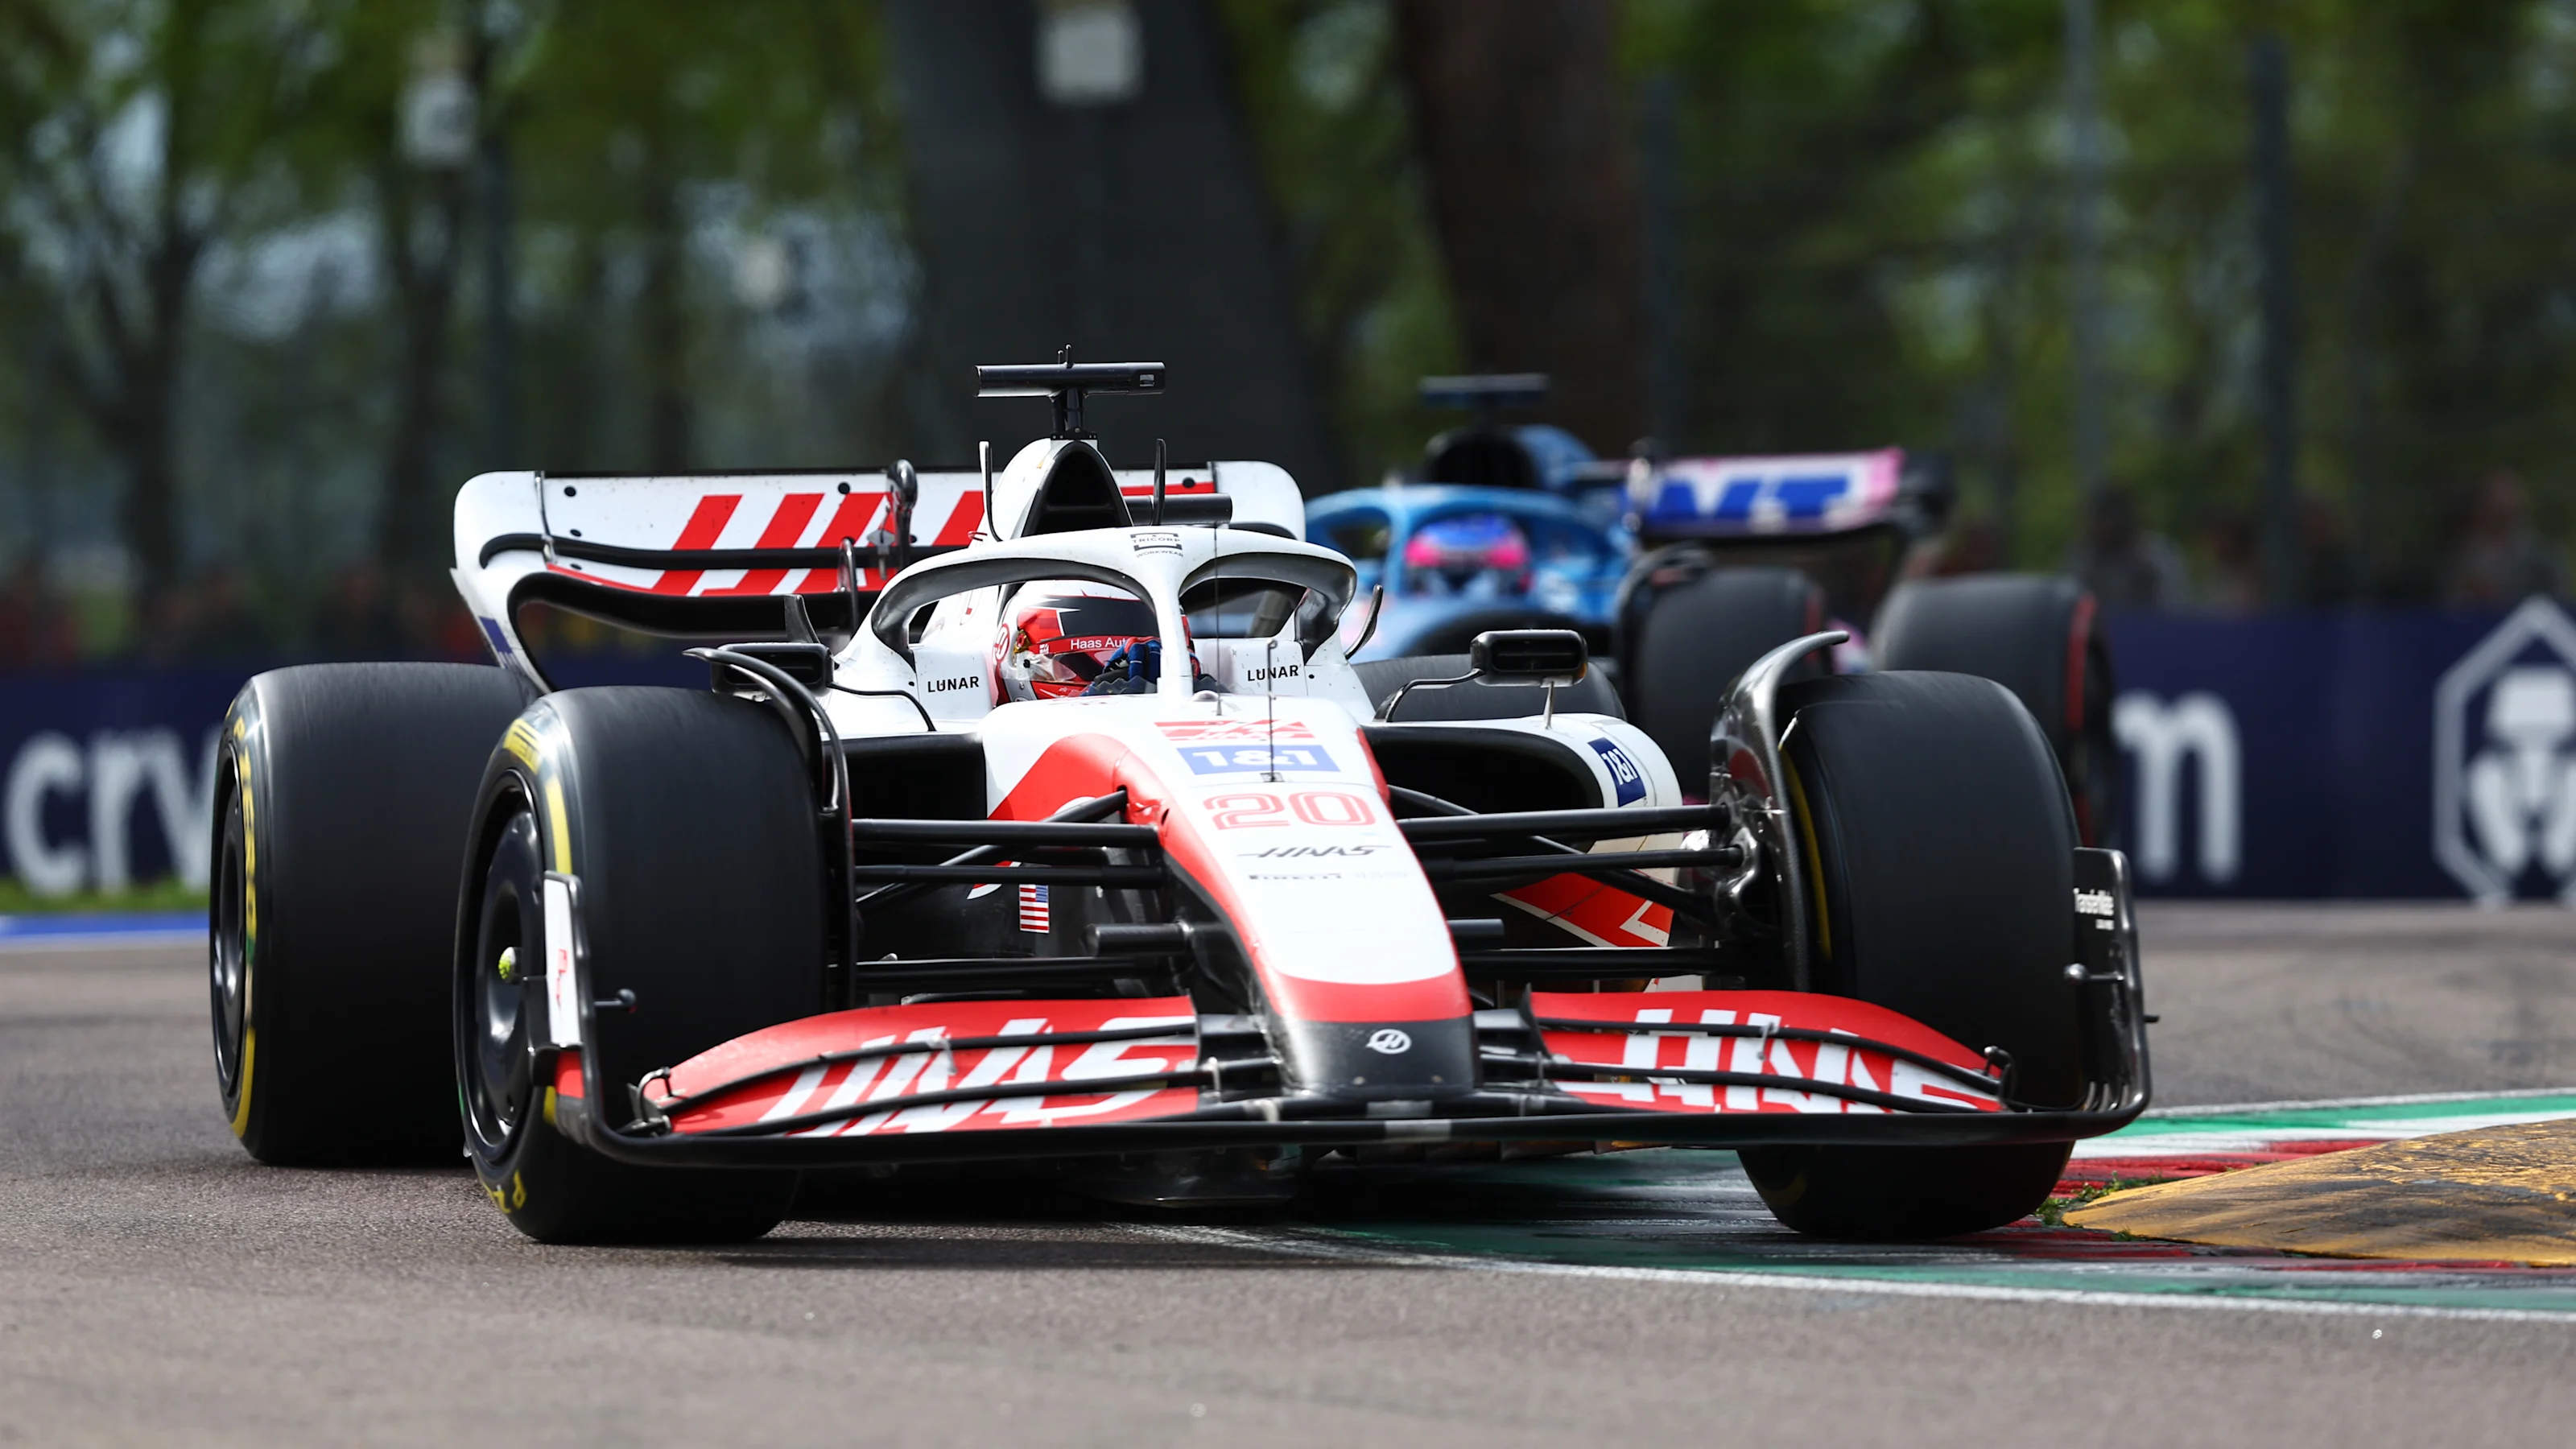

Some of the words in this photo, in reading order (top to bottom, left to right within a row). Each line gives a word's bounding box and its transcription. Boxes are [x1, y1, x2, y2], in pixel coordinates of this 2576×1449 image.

[1136, 550, 1184, 558] WORKWEAR
[1070, 638, 1102, 650] Haas
[1247, 665, 1299, 682] LUNAR
[927, 675, 979, 693] LUNAR
[1192, 749, 1319, 766] 1&1
[1601, 748, 1638, 786] 1&1
[1203, 791, 1376, 830] 20
[1236, 845, 1392, 857] HAAS
